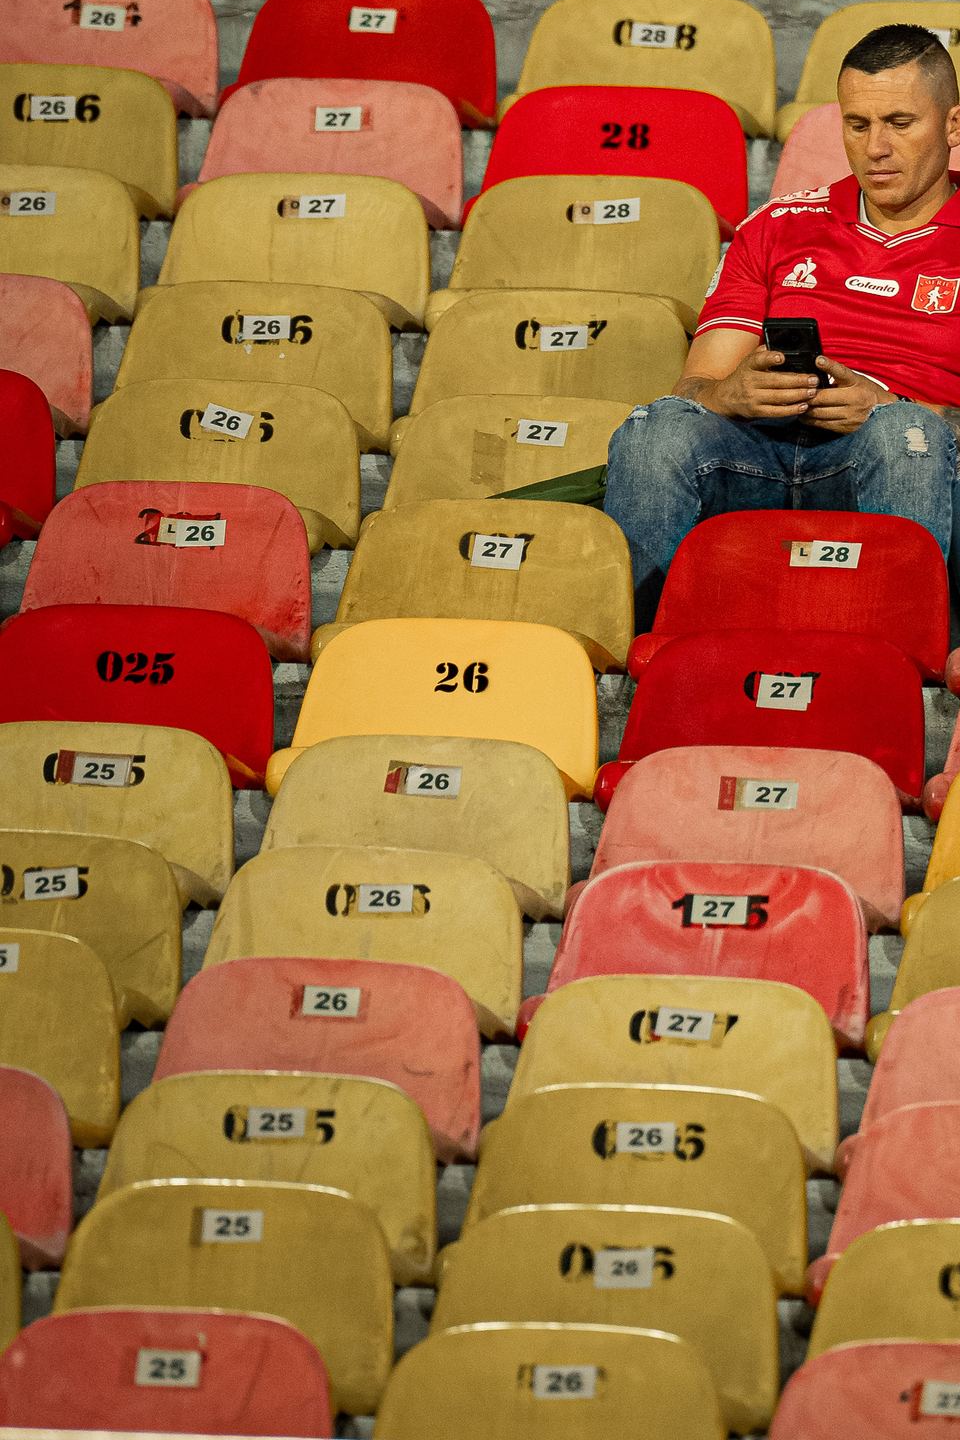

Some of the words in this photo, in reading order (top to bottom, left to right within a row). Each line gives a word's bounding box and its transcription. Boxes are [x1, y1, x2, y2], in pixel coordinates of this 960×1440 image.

[90, 11, 116, 27] 26
[359, 13, 387, 29] 27
[640, 28, 667, 44] 28
[39, 100, 66, 116] 26
[324, 112, 352, 127] 27
[601, 123, 650, 150] 28
[18, 196, 46, 212] 26
[308, 198, 336, 214] 27
[603, 203, 630, 219] 28
[252, 320, 281, 335] 26
[550, 330, 579, 347] 27
[210, 410, 242, 431] 26
[526, 424, 558, 441] 27
[168, 524, 175, 533] L
[184, 525, 215, 542] 26
[481, 541, 513, 559] 27
[800, 548, 808, 556] L
[818, 545, 850, 563] 28
[96, 651, 174, 685] 025
[435, 661, 490, 694] 26
[769, 682, 802, 699] 27
[82, 762, 116, 781] 25
[417, 772, 450, 791] 26
[754, 786, 788, 804] 27
[34, 874, 67, 895] 25
[368, 889, 401, 907] 26
[702, 900, 736, 918] 27
[313, 991, 348, 1012] 26
[667, 1013, 703, 1034] 27
[259, 1112, 294, 1132] 25
[628, 1127, 663, 1147] 26
[215, 1215, 251, 1237] 25
[611, 1259, 639, 1277] 26
[149, 1357, 187, 1381] 25
[546, 1371, 584, 1394] 26
